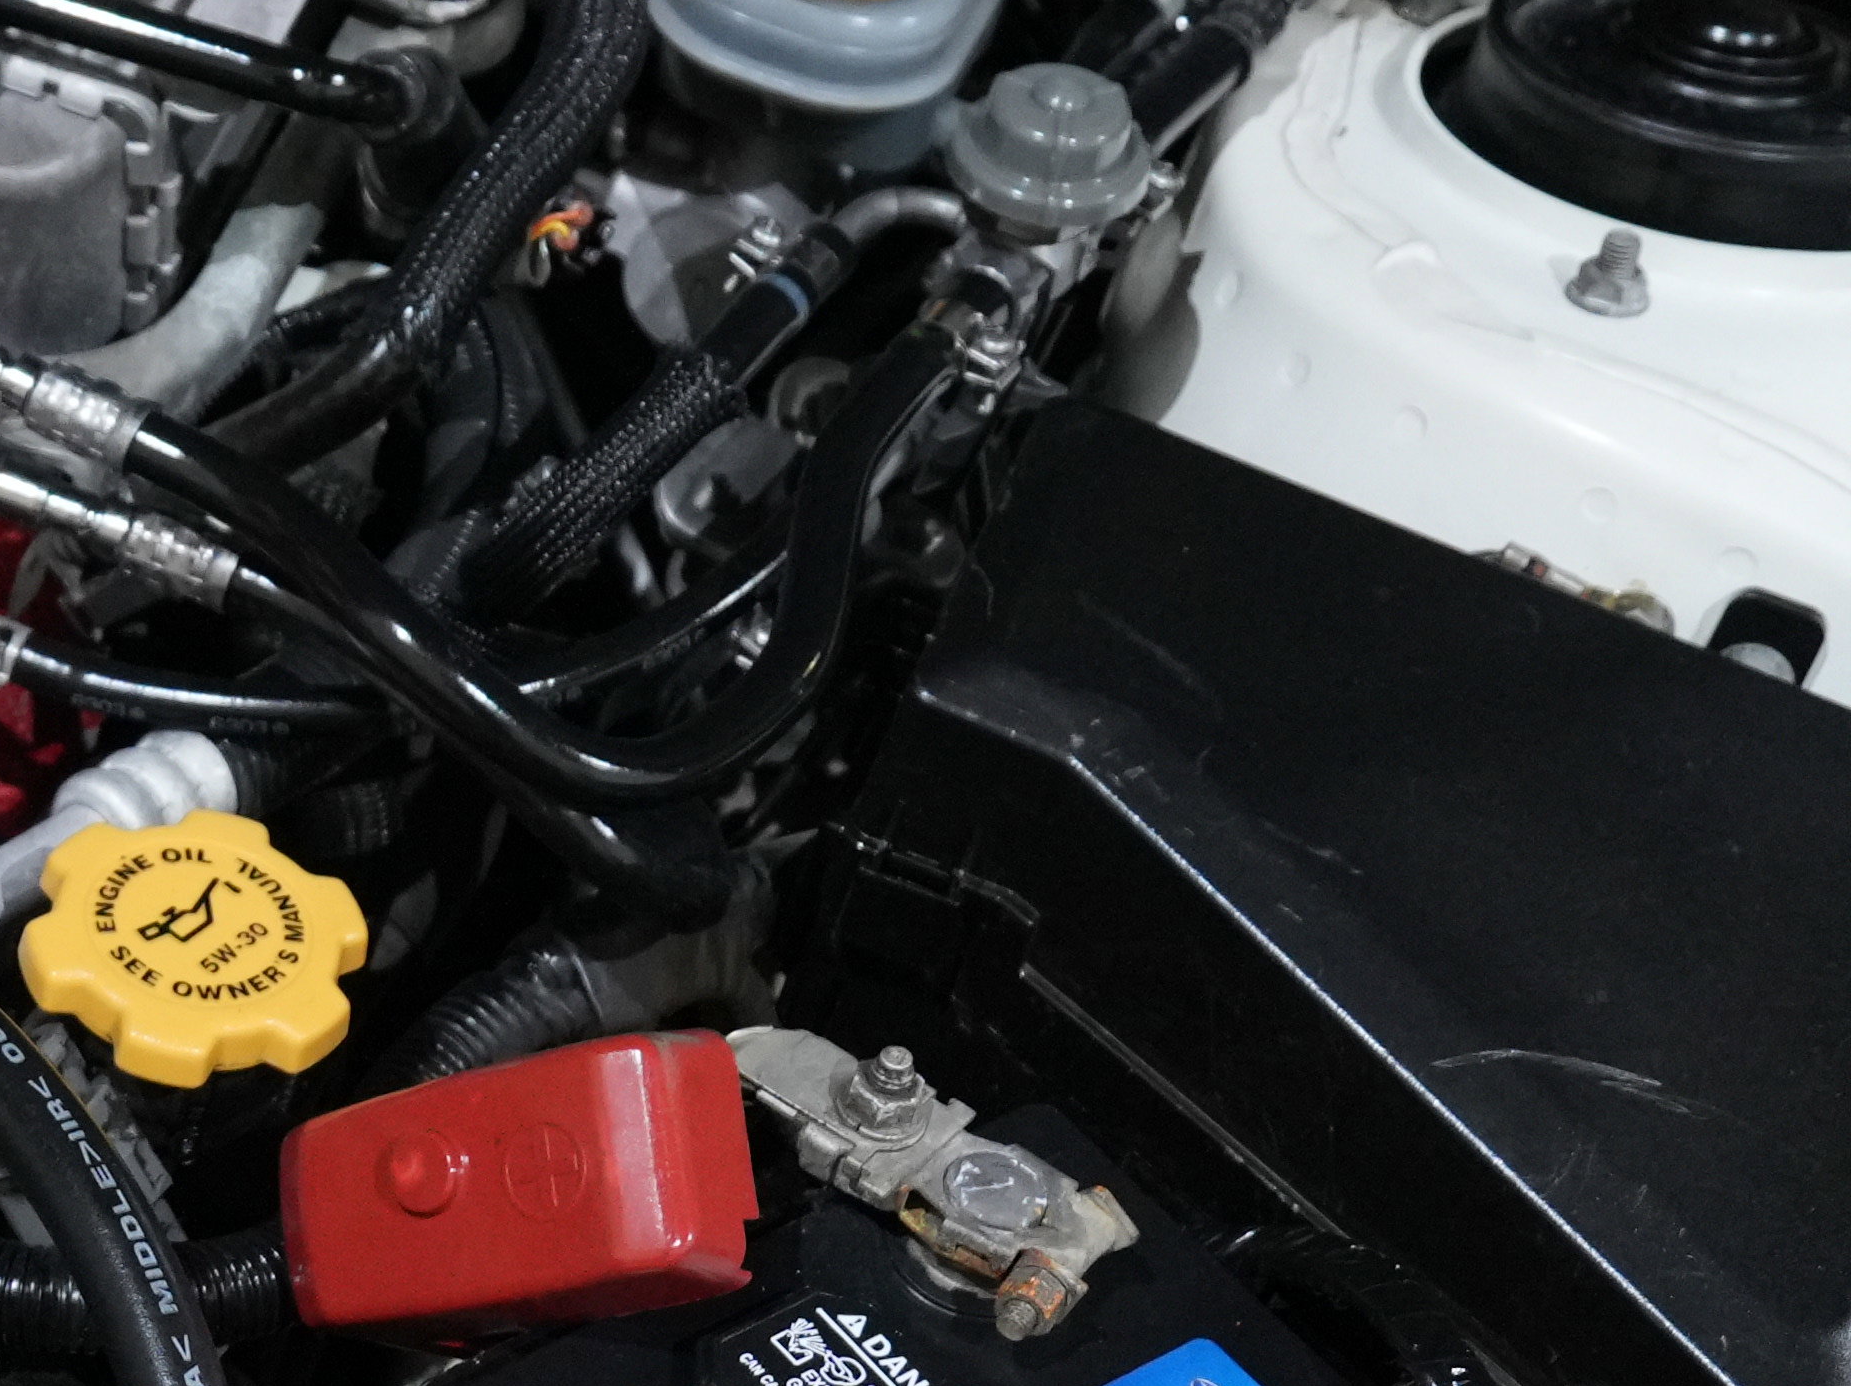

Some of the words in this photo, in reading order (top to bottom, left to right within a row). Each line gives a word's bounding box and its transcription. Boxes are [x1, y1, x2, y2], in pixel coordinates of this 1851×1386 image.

[95, 854, 155, 933] ENGINE
[161, 847, 213, 864] OIL
[110, 945, 163, 987] SEE
[236, 857, 305, 943] MANUAL
[199, 922, 269, 974] 5W-30
[736, 1352, 765, 1377] CAN
